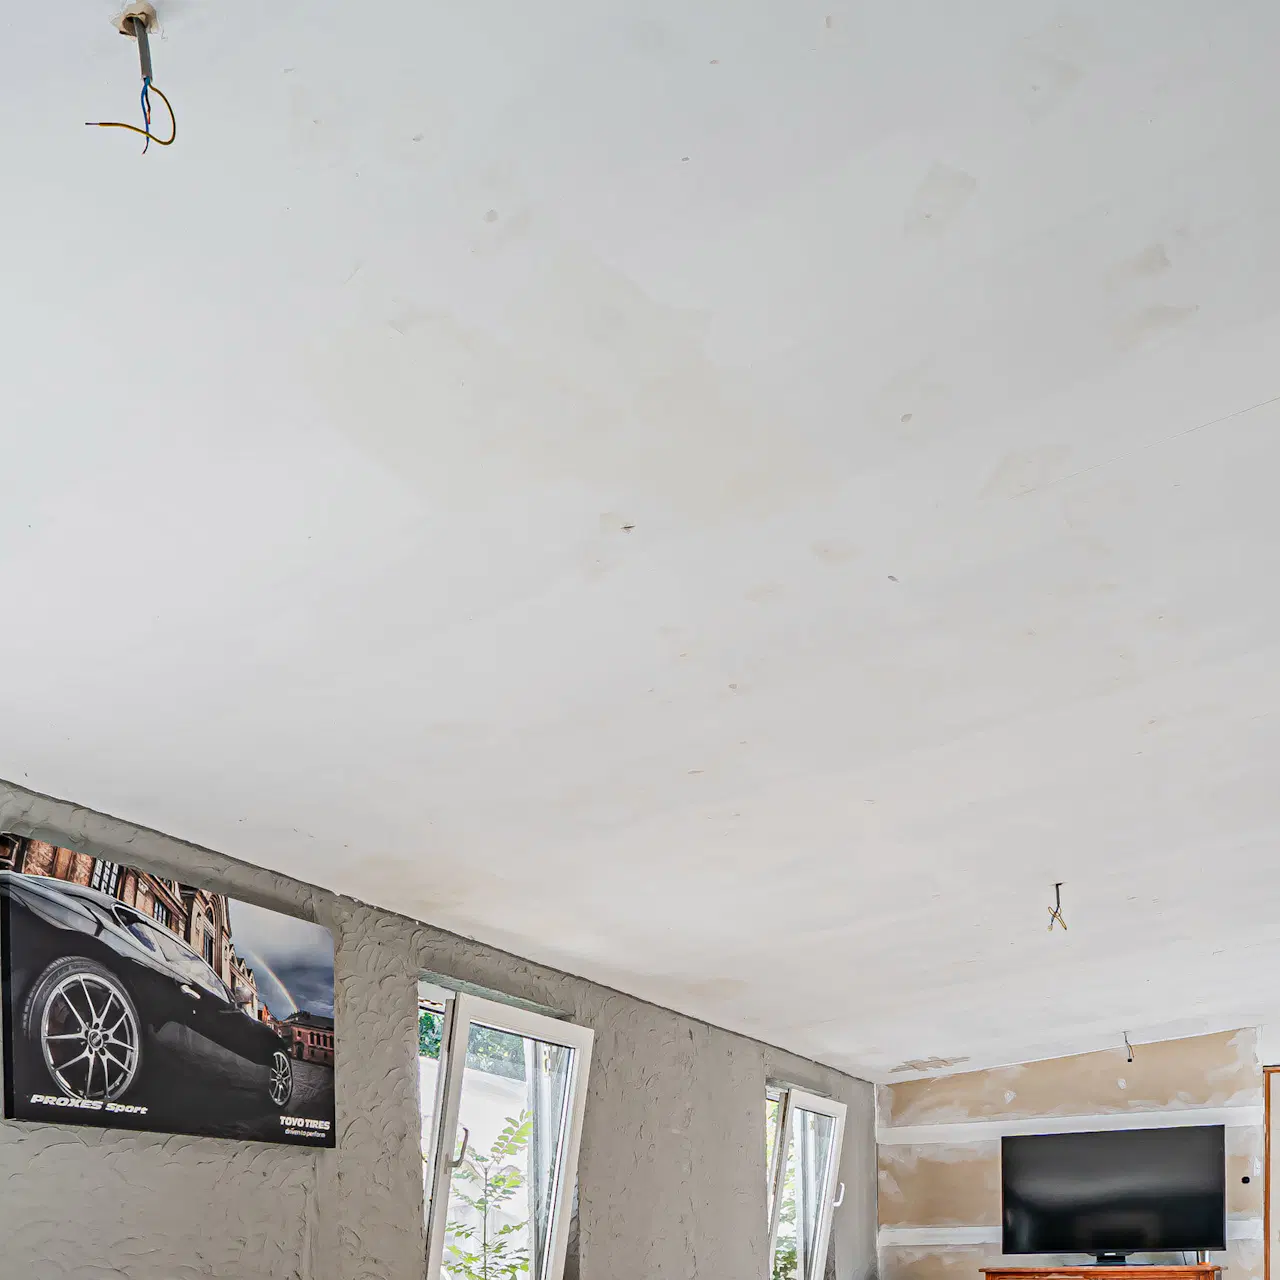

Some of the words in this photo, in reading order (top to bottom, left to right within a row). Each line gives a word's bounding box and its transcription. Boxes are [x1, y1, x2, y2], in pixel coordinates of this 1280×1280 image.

[30, 1094, 104, 1109] PROXES
[105, 1102, 148, 1115] Sport
[280, 1115, 304, 1128] TOYO
[305, 1118, 331, 1130] TIRES
